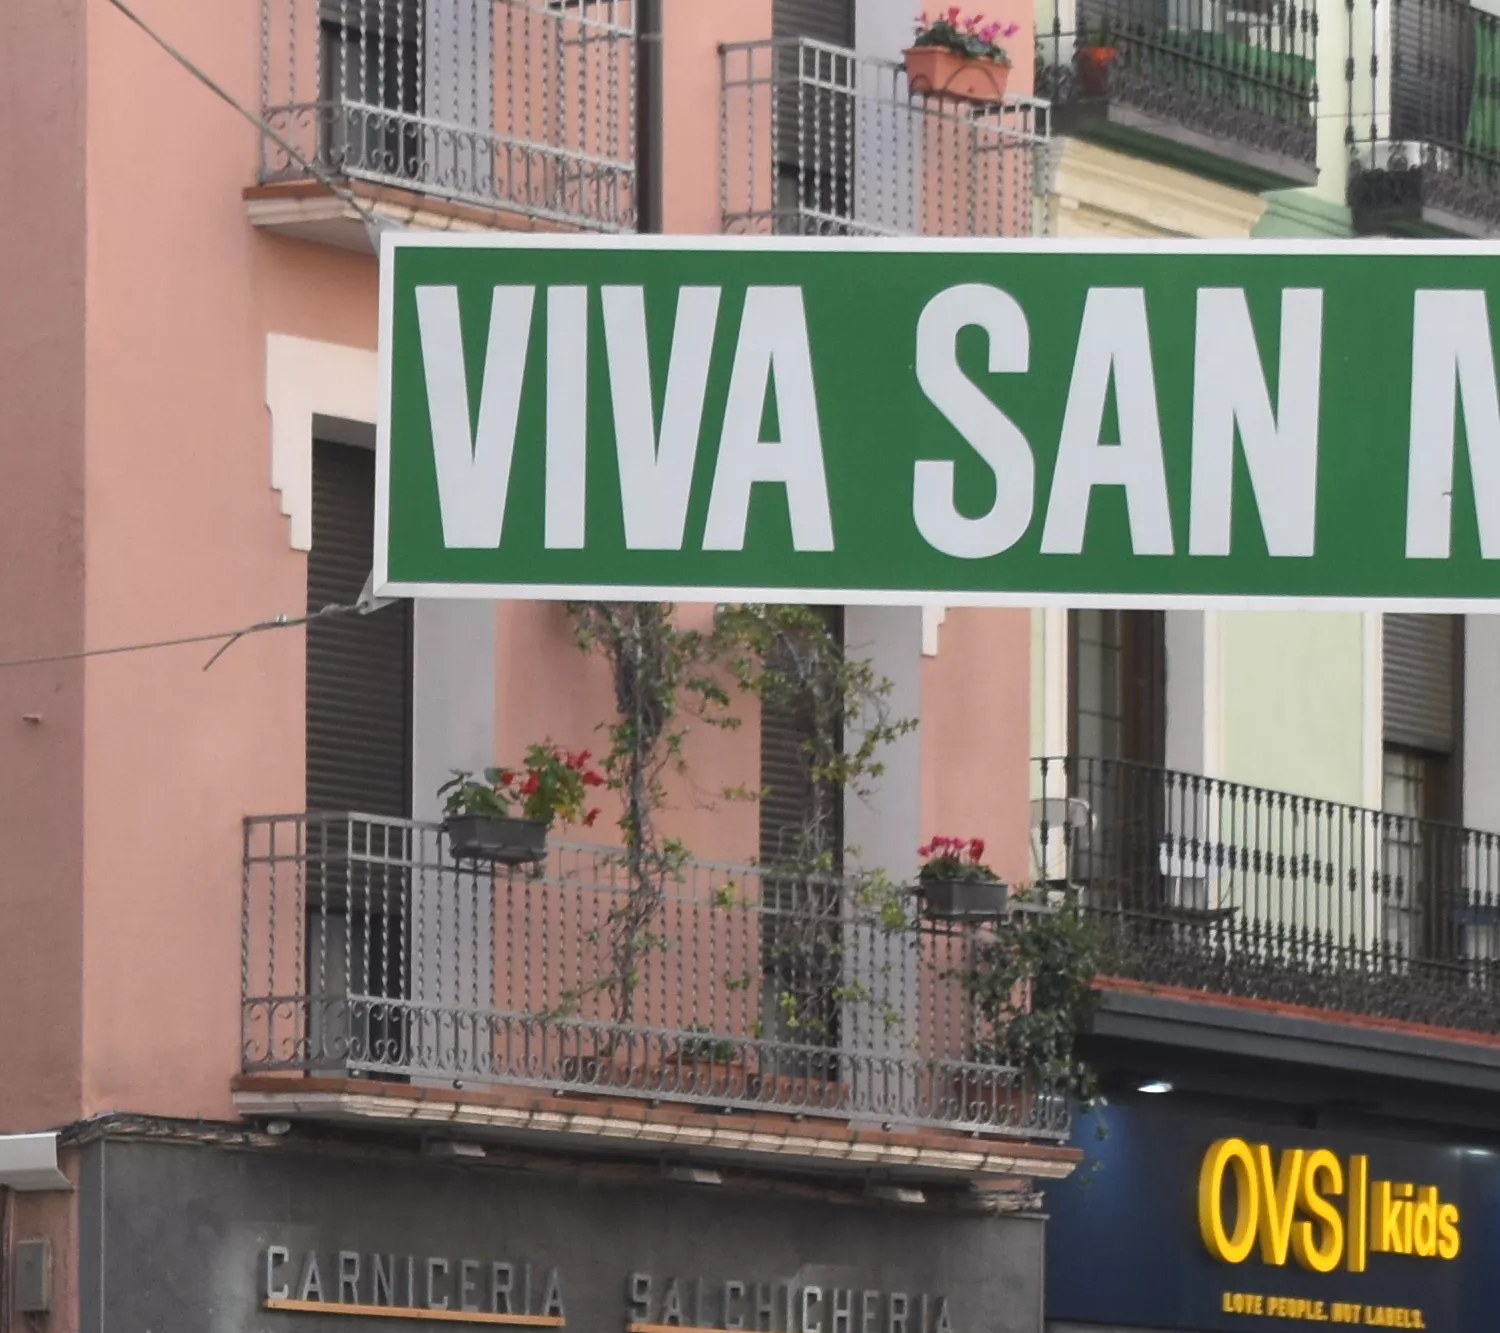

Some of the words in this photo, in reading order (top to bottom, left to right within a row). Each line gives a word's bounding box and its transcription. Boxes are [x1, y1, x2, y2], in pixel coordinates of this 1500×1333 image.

[415, 284, 836, 551] VIVA
[912, 282, 1320, 559] SAN
[1199, 1138, 1344, 1273] OVS
[1370, 1180, 1461, 1260] kids
[267, 1245, 566, 1318] CARNICERIA
[1222, 1292, 1264, 1315] LOVE
